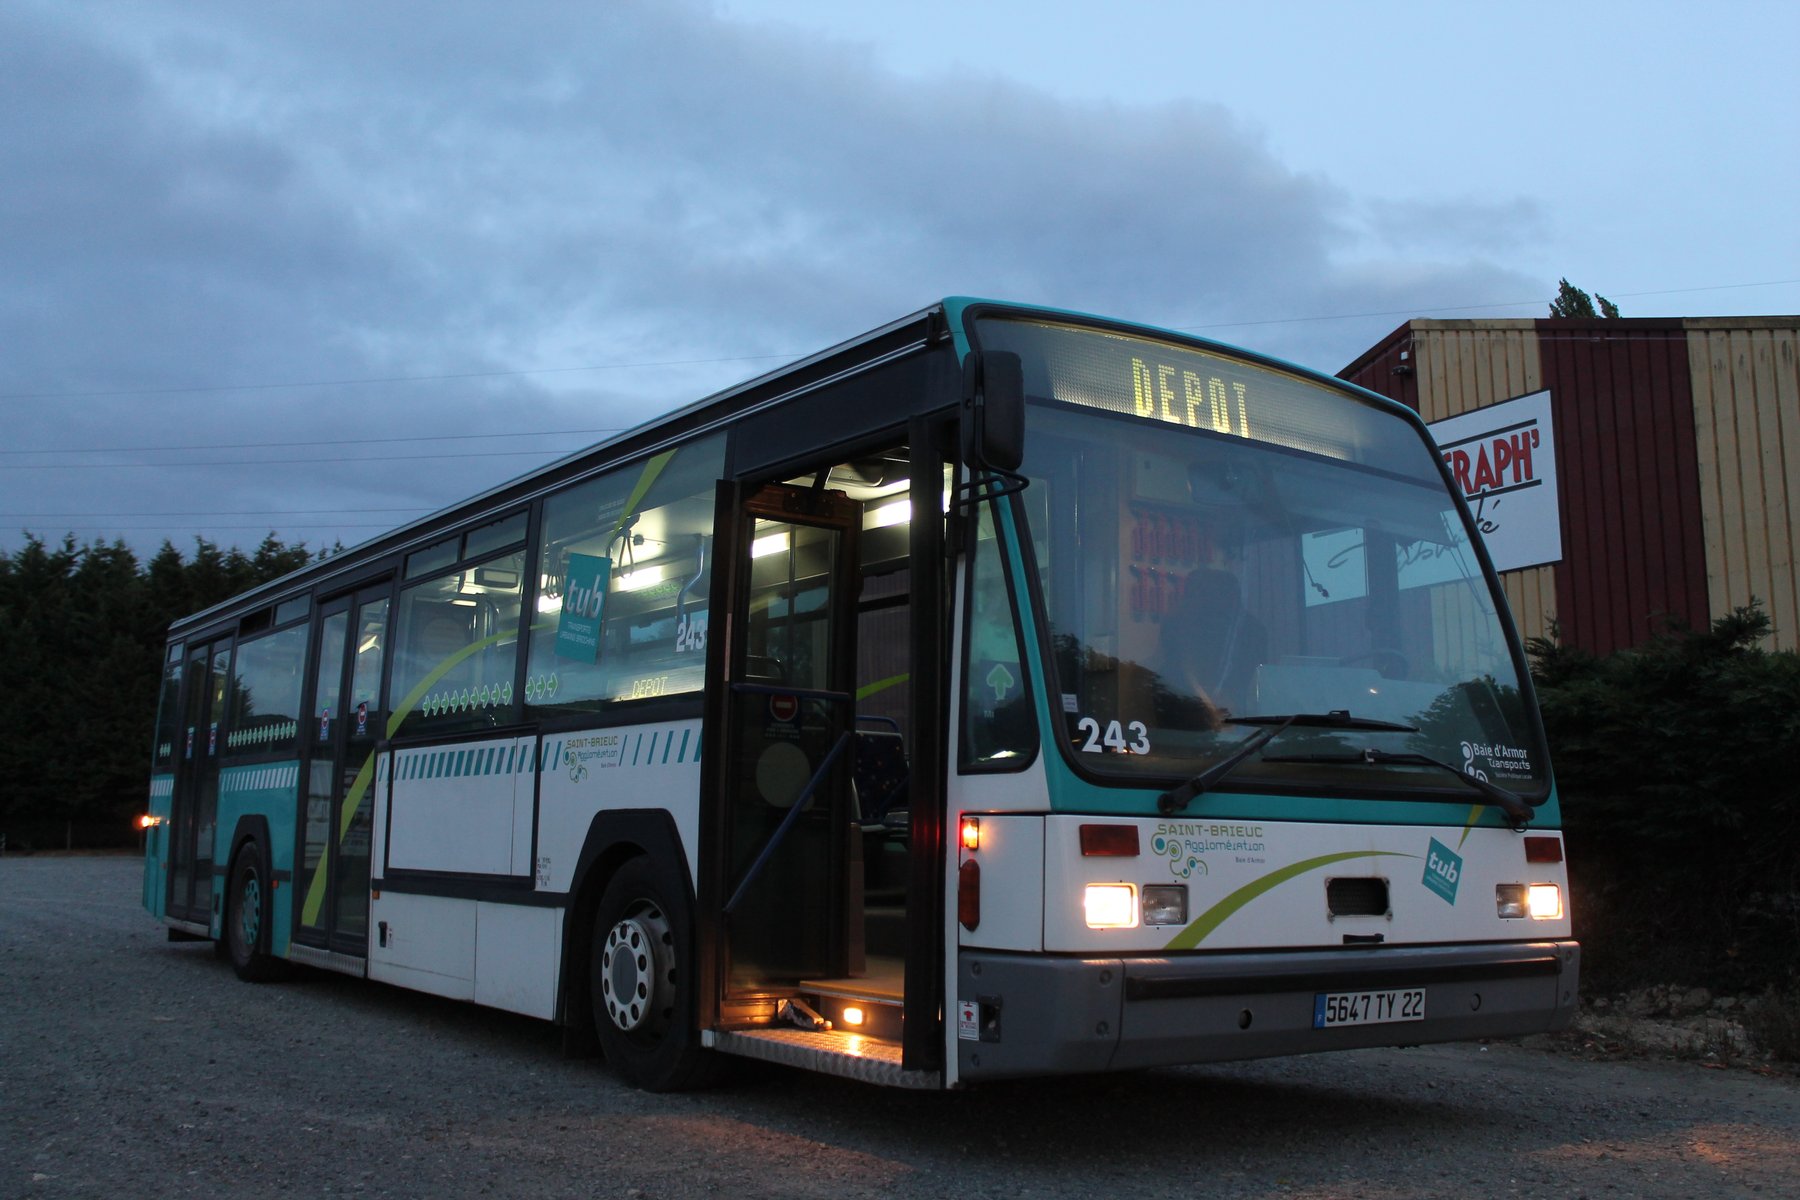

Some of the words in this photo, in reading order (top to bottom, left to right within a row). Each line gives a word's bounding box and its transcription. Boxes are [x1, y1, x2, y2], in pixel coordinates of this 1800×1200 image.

[1132, 357, 1250, 439] DEPOT
[565, 574, 603, 619] tub
[676, 620, 707, 653] 243
[631, 676, 669, 699] DEPOT
[567, 735, 619, 748] SAINT-BRIEUC
[1078, 717, 1151, 755] 243
[1473, 743, 1493, 756] Baie
[1494, 744, 1528, 759] d'Armor
[1487, 757, 1531, 771] Transports
[1157, 824, 1264, 838] SAINT-BRIEUC
[1428, 851, 1458, 884] tub
[1326, 994, 1371, 1022] 5647
[1376, 993, 1396, 1019] TY
[1401, 991, 1423, 1017] 22
